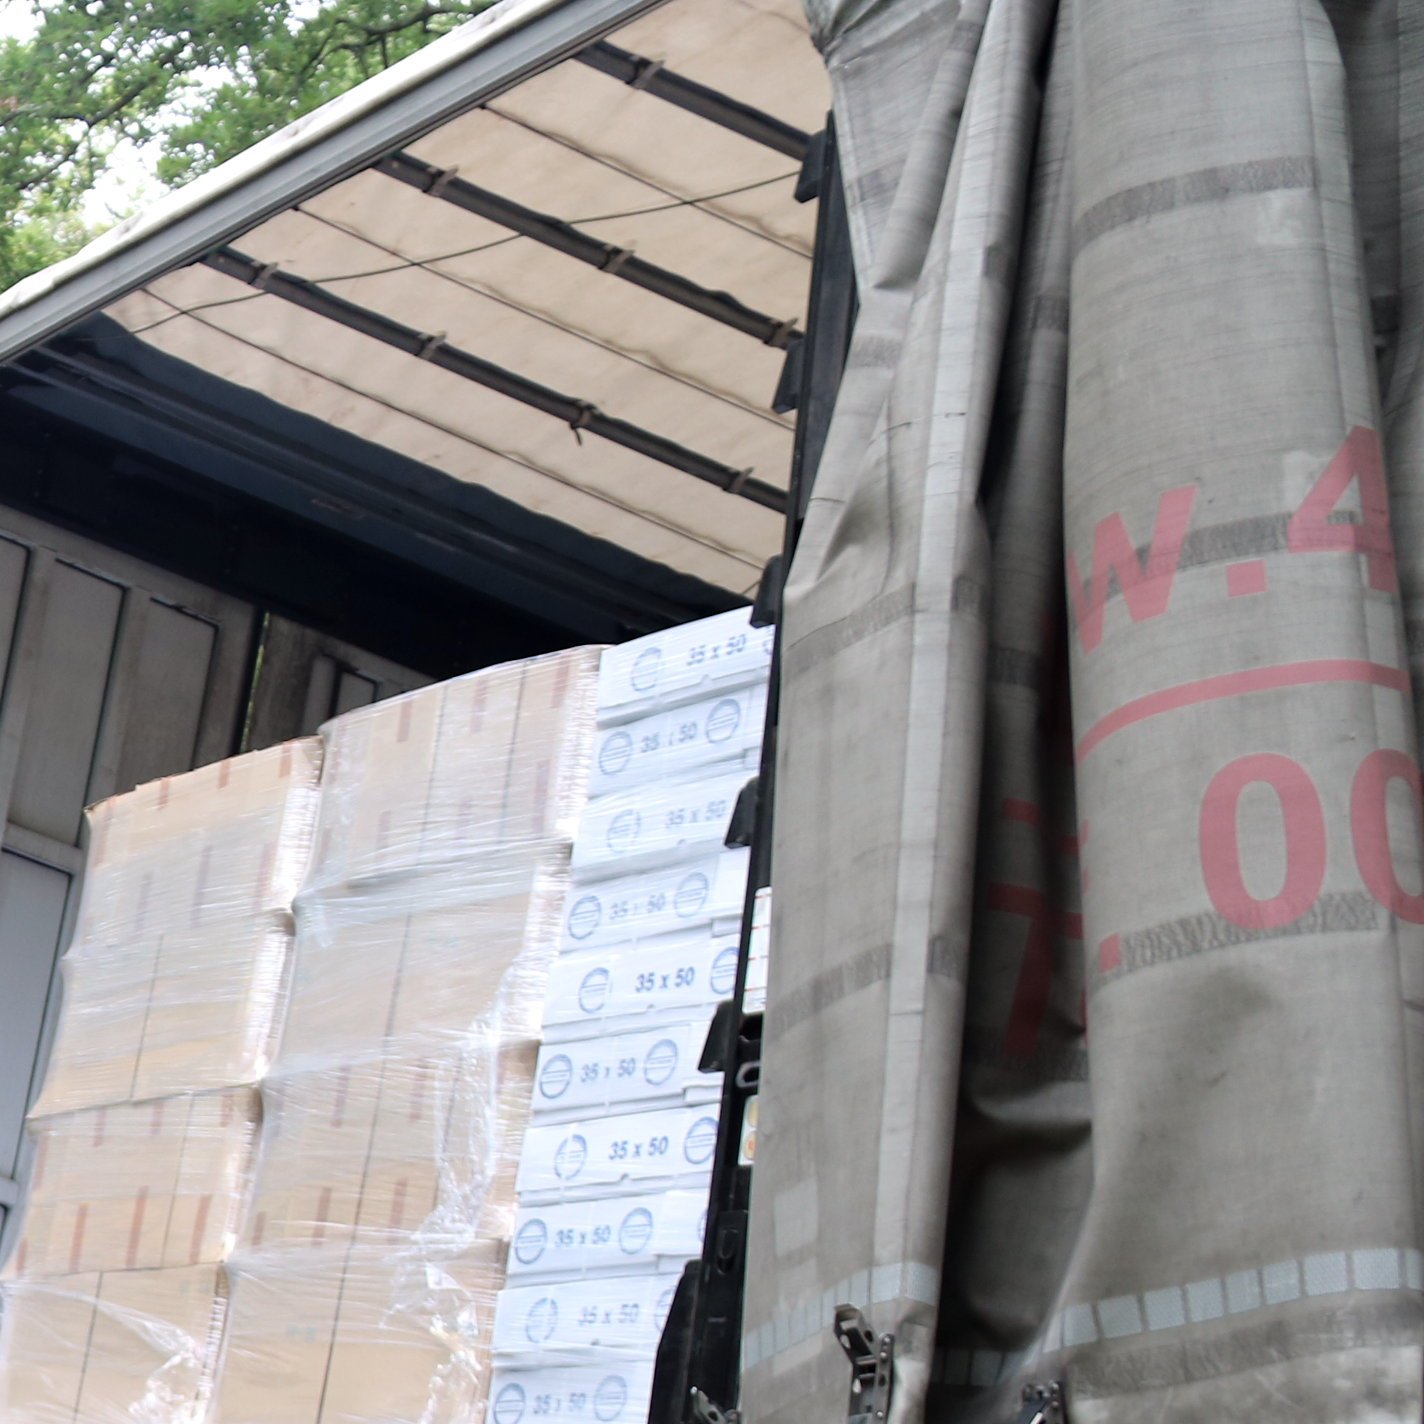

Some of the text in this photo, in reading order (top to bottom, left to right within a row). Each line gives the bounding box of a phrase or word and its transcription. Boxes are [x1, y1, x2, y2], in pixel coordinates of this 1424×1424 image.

[634, 973, 654, 993] 35
[675, 966, 696, 988] 50
[580, 1063, 599, 1083] 35
[617, 1057, 637, 1078] 50
[609, 1140, 629, 1161] 35
[648, 1135, 669, 1156] 50
[554, 1228, 574, 1248] 35
[592, 1225, 611, 1245] 50
[618, 1303, 640, 1324] 50
[567, 1392, 587, 1412] 50
